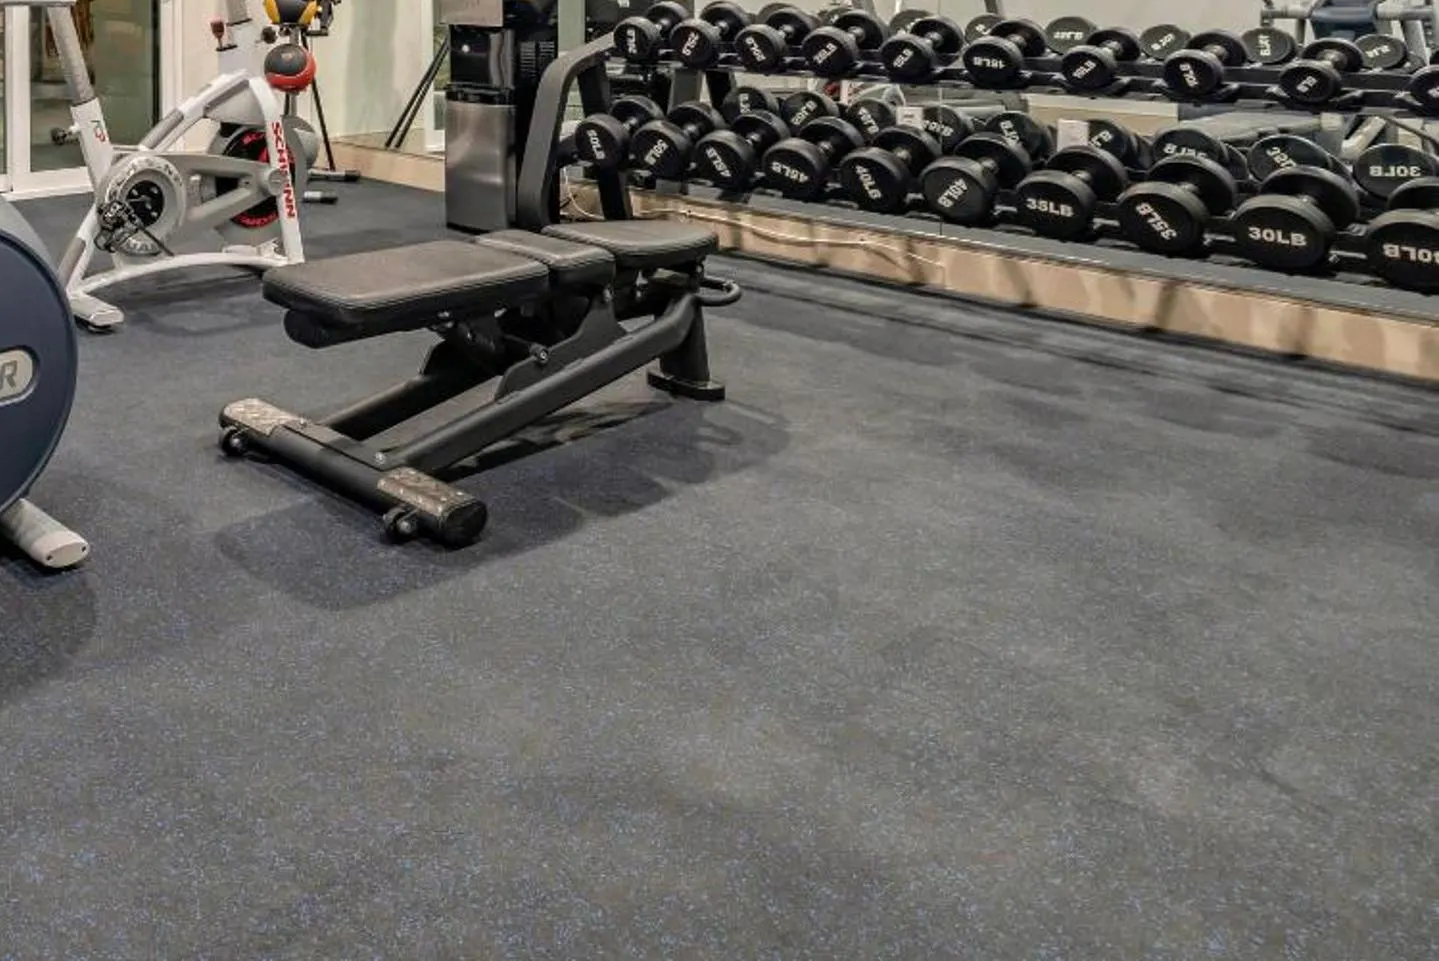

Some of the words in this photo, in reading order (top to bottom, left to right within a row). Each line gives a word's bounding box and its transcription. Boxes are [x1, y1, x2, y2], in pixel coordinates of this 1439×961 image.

[1026, 197, 1074, 218] 35LB
[1135, 202, 1177, 240] 35LB
[1248, 226, 1307, 247] 30LB
